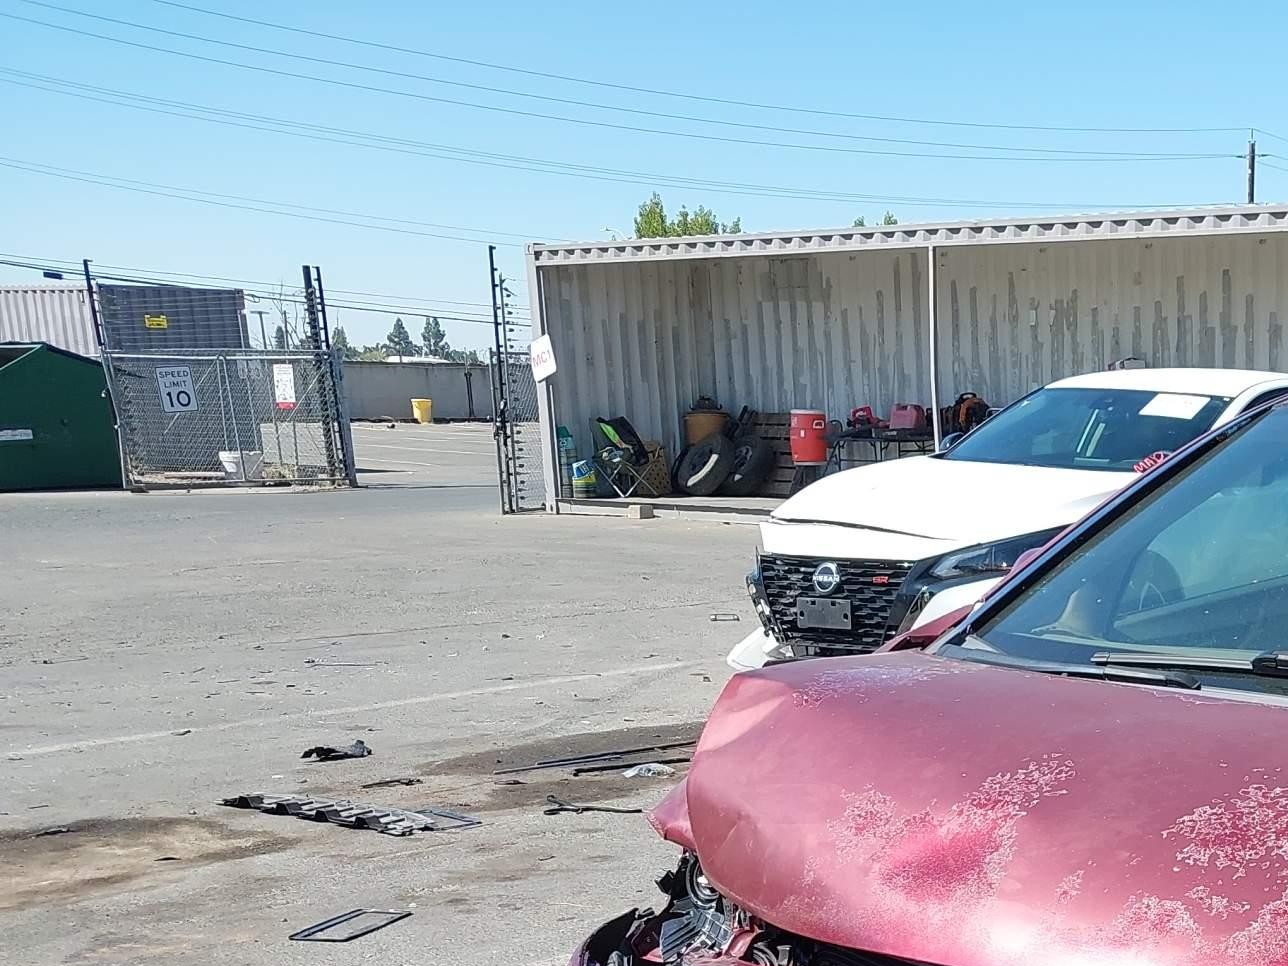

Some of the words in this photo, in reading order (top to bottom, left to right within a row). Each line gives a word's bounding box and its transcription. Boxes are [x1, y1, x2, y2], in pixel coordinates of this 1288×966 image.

[158, 370, 189, 379] SPEED
[164, 380, 188, 389] LIMIT
[166, 390, 191, 408] 10
[813, 574, 840, 583] NISSAN
